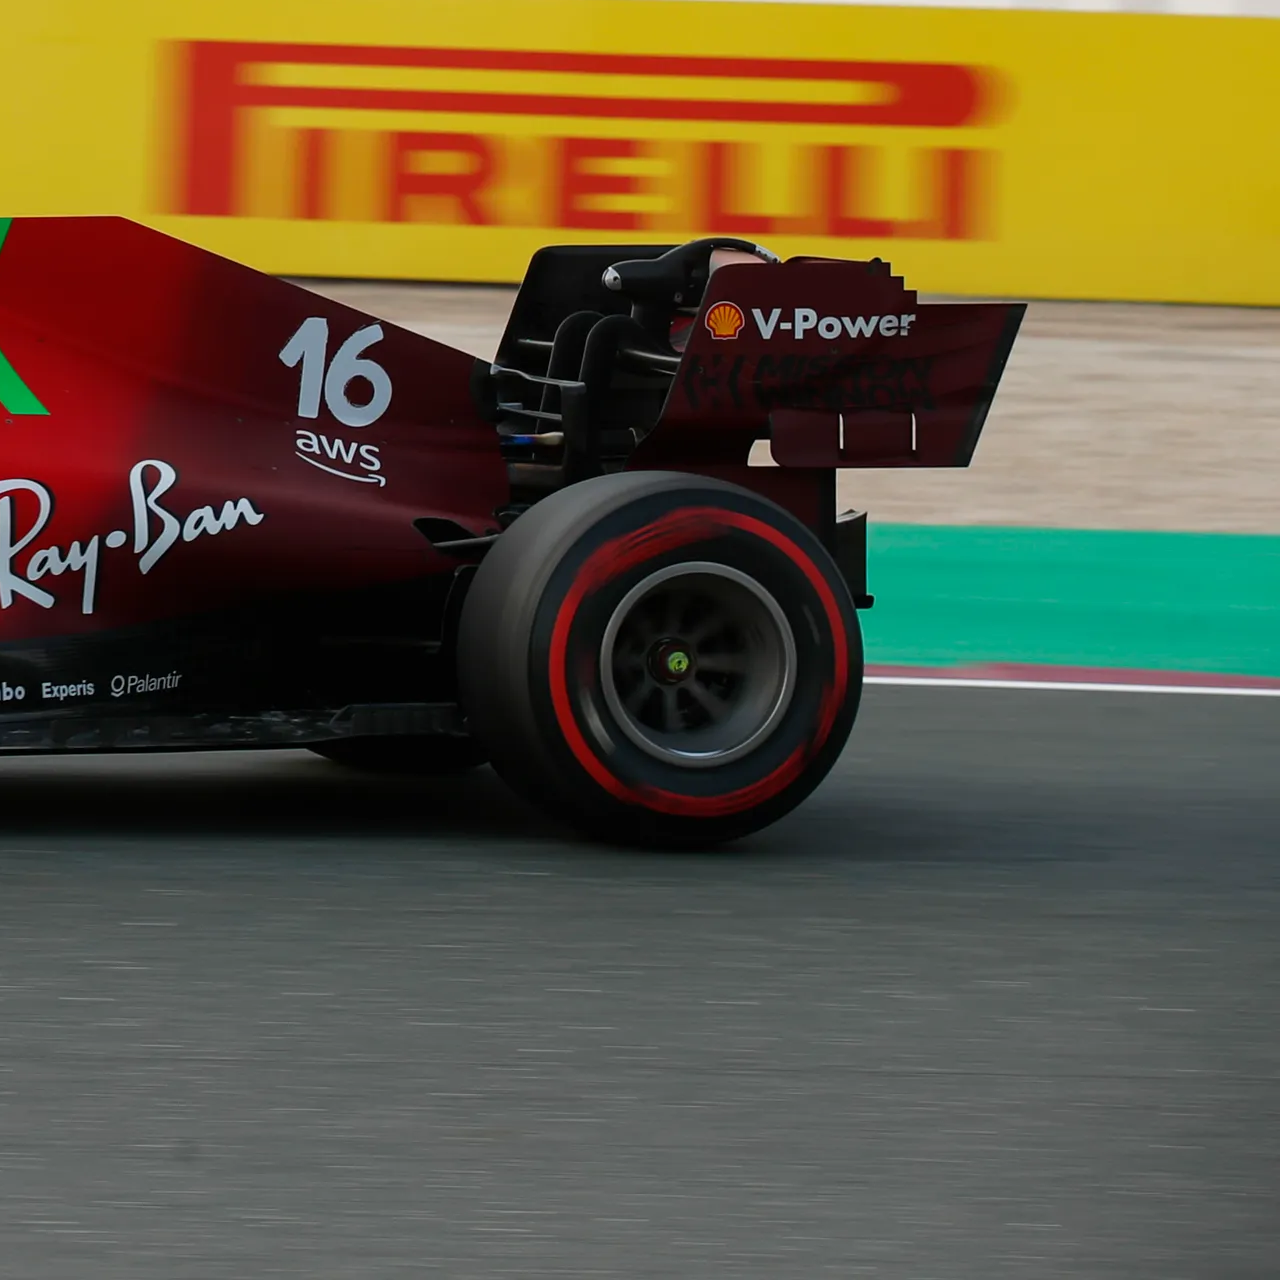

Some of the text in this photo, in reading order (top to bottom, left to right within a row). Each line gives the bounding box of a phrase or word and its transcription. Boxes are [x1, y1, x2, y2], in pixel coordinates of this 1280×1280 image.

[155, 39, 1015, 240] PIRELLI
[751, 308, 916, 340] V-Power
[278, 316, 393, 427] 16
[295, 429, 382, 471] aws
[41, 679, 95, 700] Experis
[127, 671, 183, 694] Palantir
